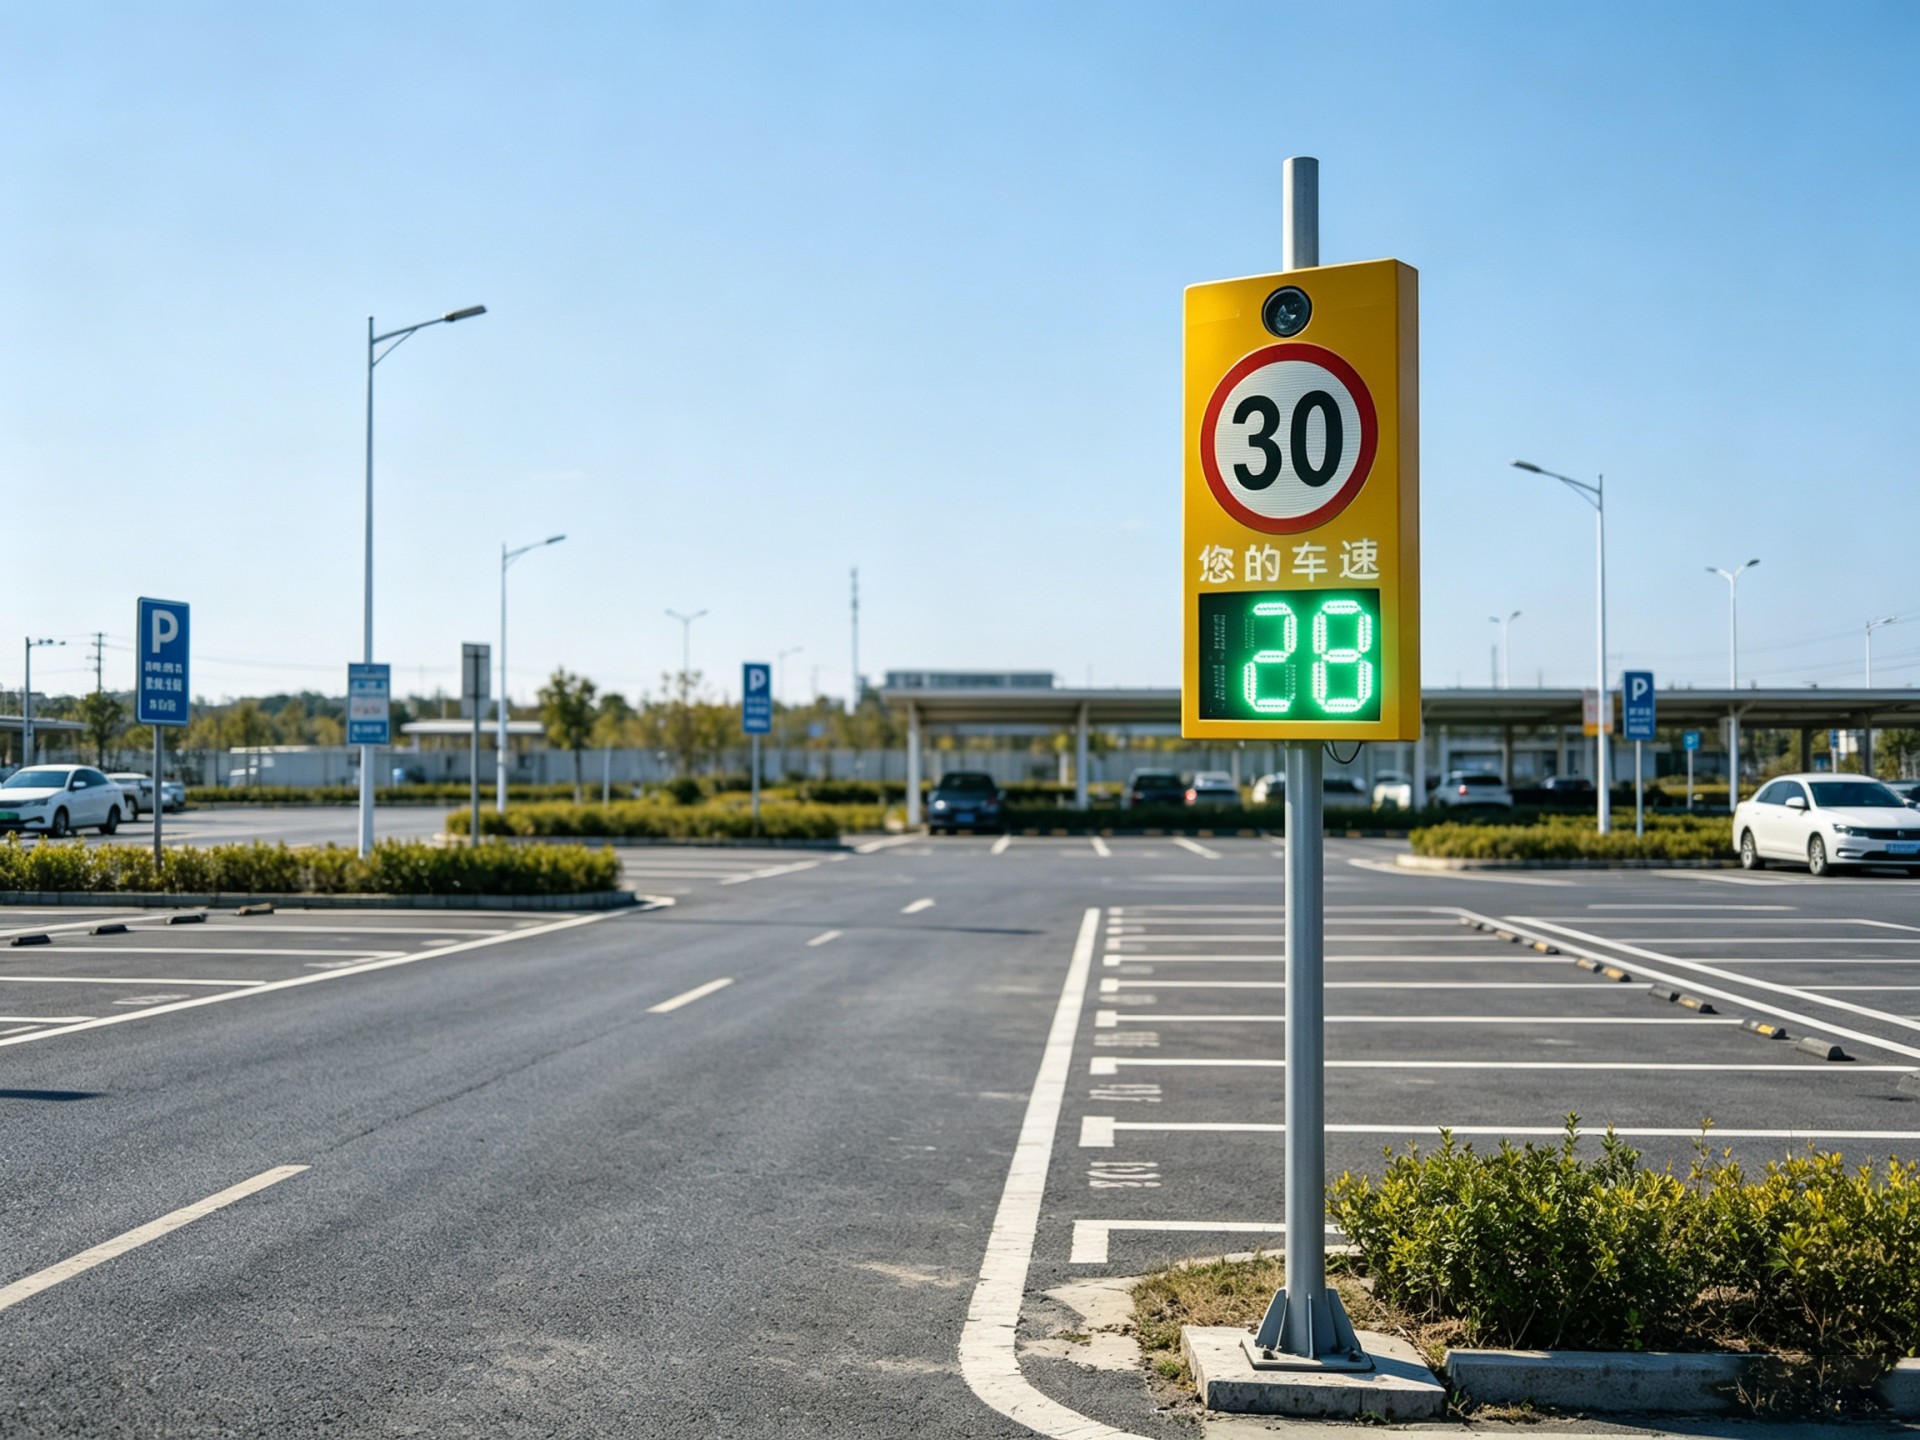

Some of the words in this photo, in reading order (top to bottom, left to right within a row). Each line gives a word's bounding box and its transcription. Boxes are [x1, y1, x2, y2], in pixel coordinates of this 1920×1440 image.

[1232, 390, 1343, 490] 30
[1198, 538, 1380, 584] 您的车速
[152, 609, 179, 653] P
[1243, 600, 1372, 713] 28
[749, 668, 767, 692] P
[1632, 678, 1648, 701] P
